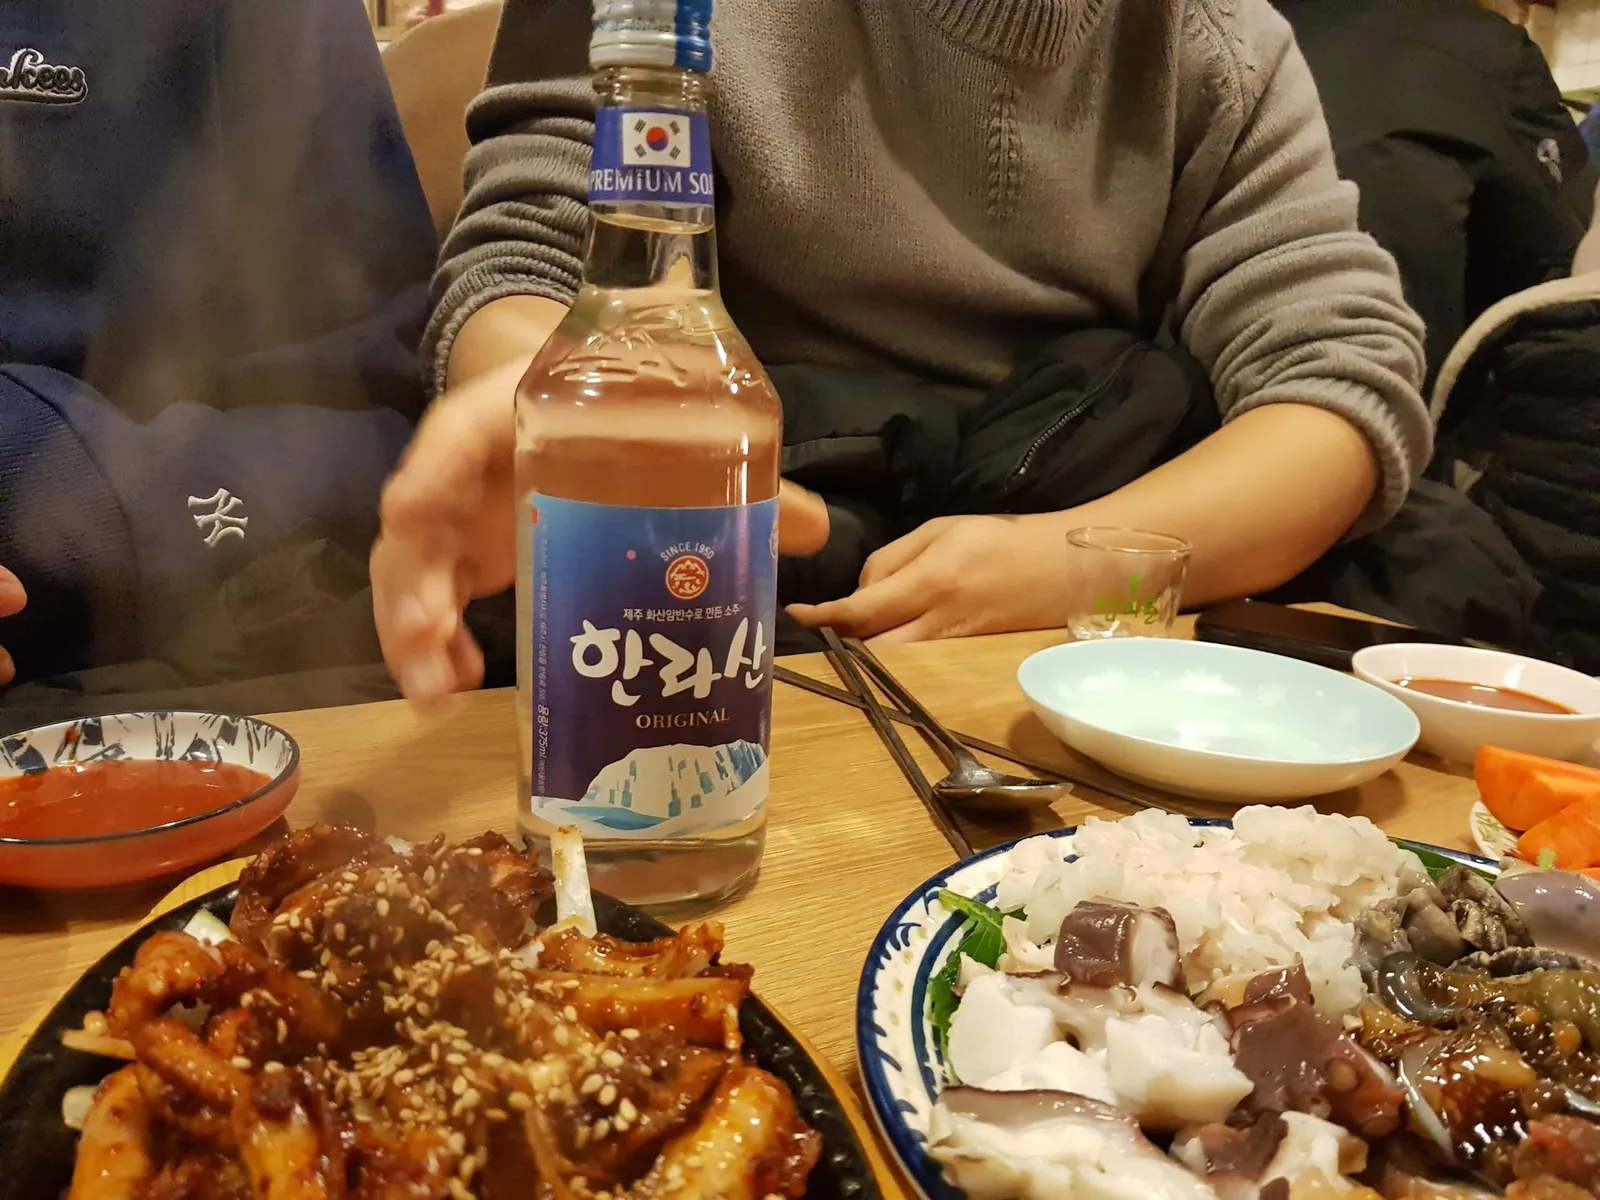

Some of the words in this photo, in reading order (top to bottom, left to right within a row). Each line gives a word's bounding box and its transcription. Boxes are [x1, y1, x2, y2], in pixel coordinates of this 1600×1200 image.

[660, 542, 691, 562] SINCE
[695, 542, 715, 560] 1950
[622, 608, 643, 620] 제주
[646, 608, 703, 622] 화산암반수로
[706, 606, 723, 619] 만든
[724, 603, 741, 617] 소주
[569, 617, 767, 706] 한라산
[635, 708, 730, 729] ORIGINAL
